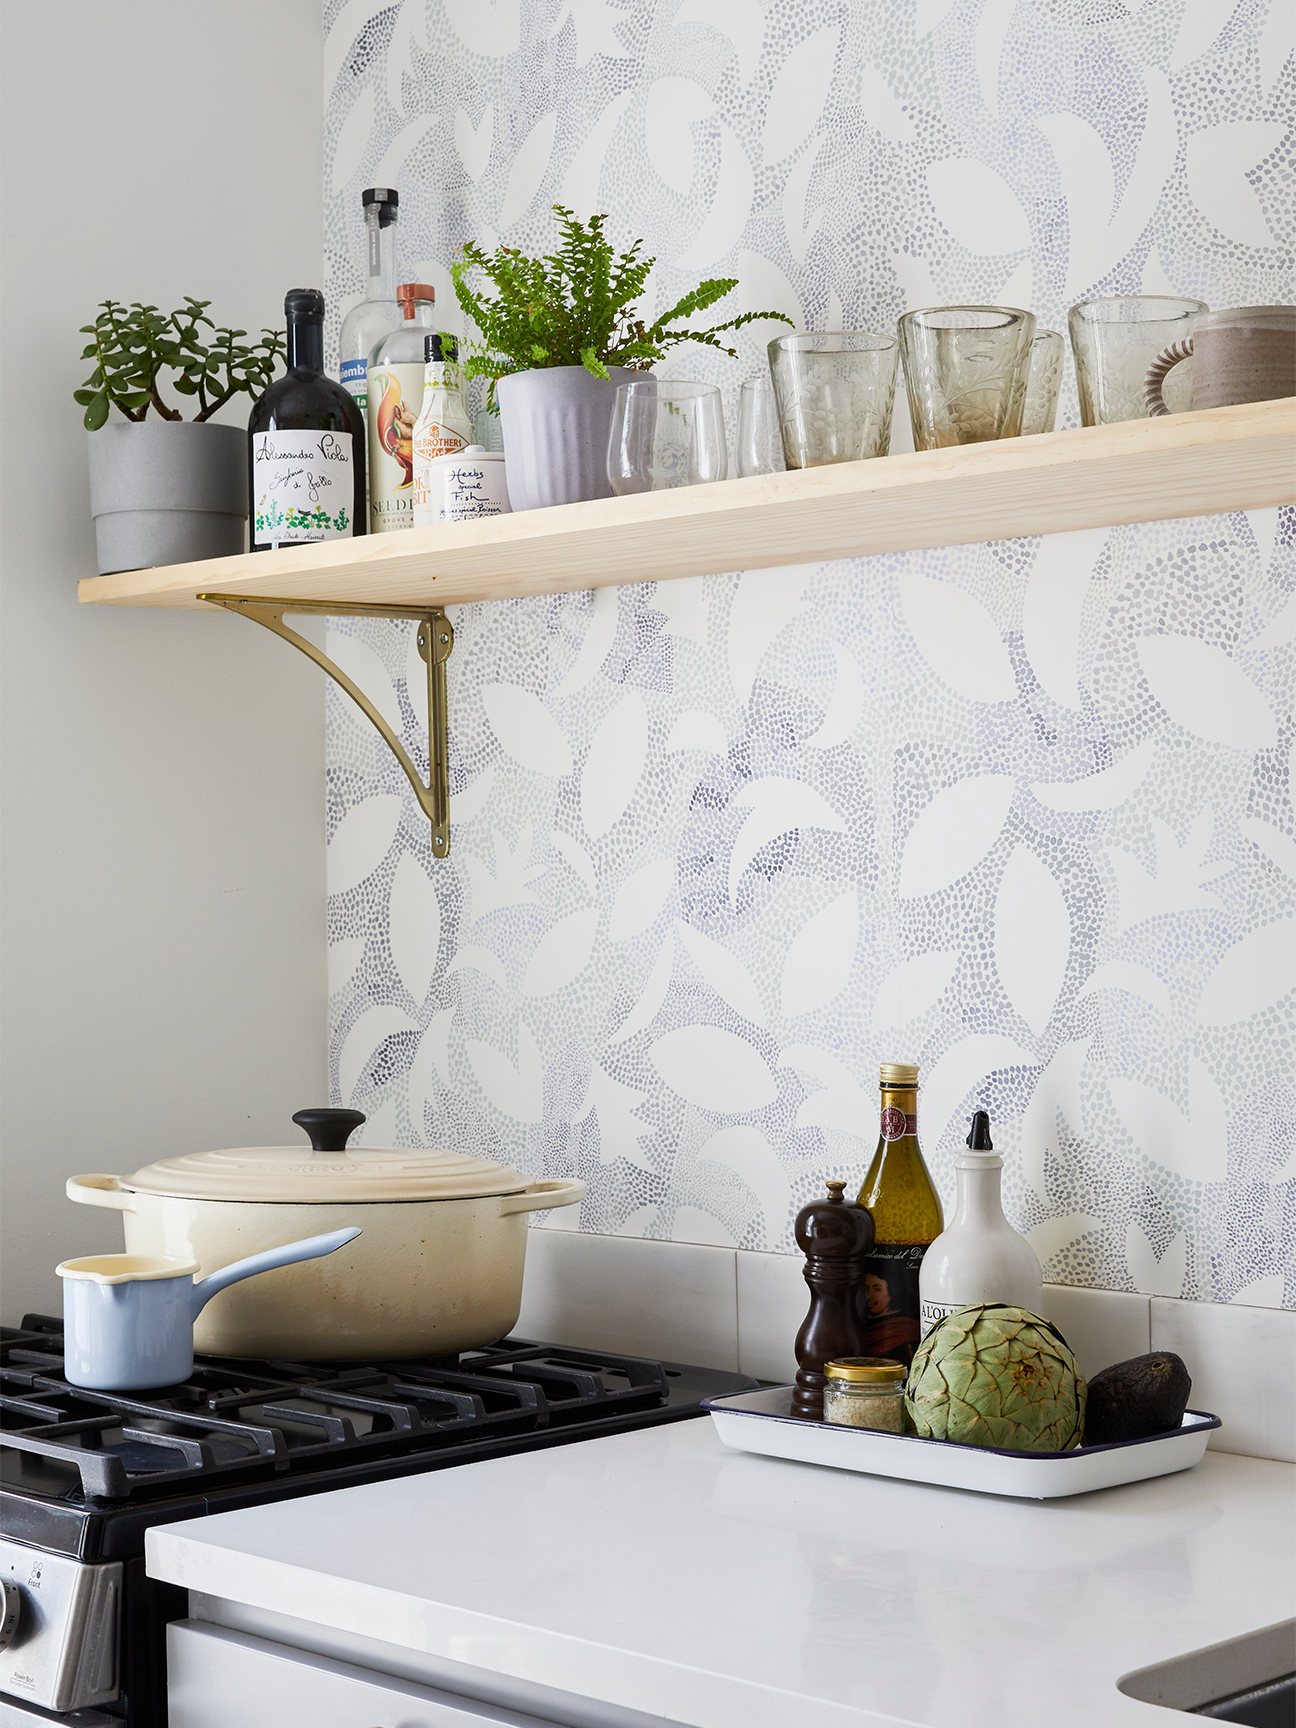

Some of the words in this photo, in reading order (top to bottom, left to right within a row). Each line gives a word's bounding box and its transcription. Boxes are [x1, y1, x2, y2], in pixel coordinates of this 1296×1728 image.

[422, 437, 462, 448] BROTHERS
[256, 435, 315, 464] Alessandro
[316, 433, 349, 462] Viola
[447, 468, 484, 485] Herbs
[457, 482, 482, 490] special
[450, 490, 490, 502] Fish
[893, 1249, 910, 1260] del
[28, 1578, 41, 1589] Front
